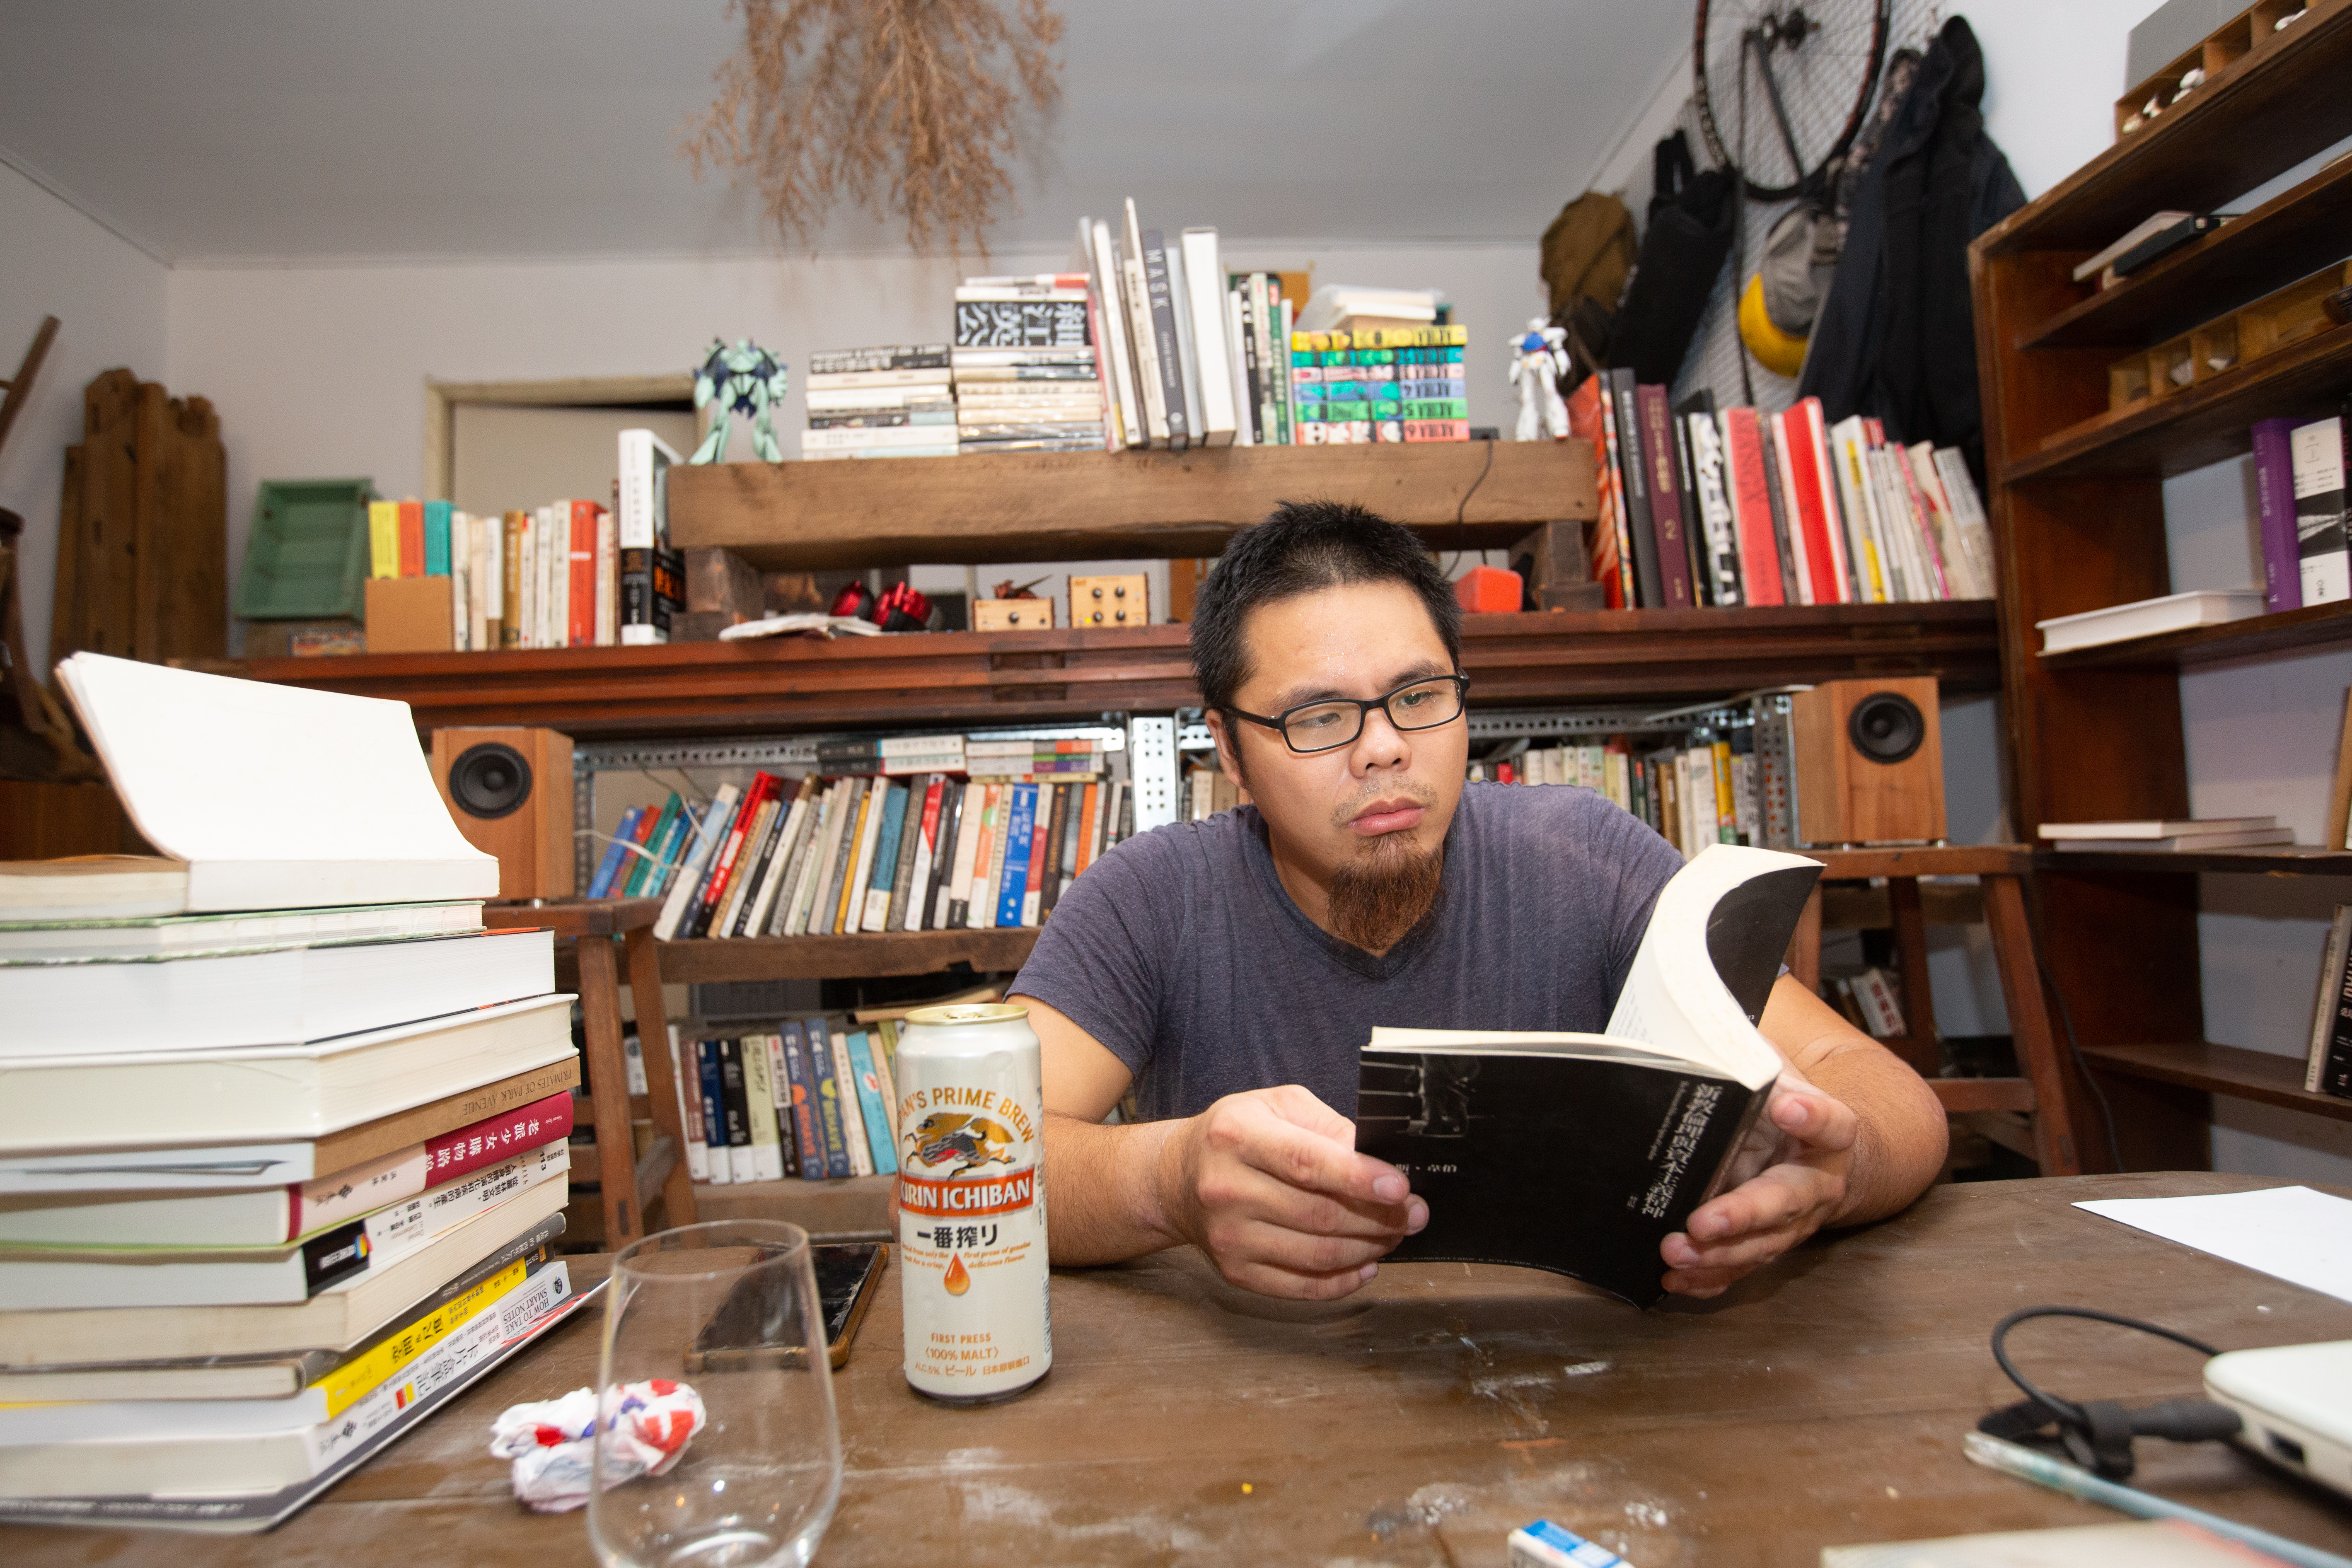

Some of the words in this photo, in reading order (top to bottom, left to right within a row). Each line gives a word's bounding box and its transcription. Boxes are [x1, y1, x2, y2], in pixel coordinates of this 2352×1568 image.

[958, 302, 1086, 346] 細江英公
[525, 1082, 535, 1094] OF
[538, 1069, 572, 1089] PRIMATES
[501, 1085, 522, 1103] PARK
[463, 1094, 496, 1116] AVENUE
[931, 1086, 996, 1111] PRIME
[998, 1098, 1034, 1144] BREW
[1641, 1082, 1724, 1219] 新教倫理與資本主義精神
[900, 1181, 938, 1210] KIRIN
[942, 1177, 1030, 1210] ICHIBAN
[917, 1223, 998, 1249] 一番搾り
[526, 1288, 547, 1309] SMART
[534, 1297, 549, 1316] HOW
[503, 1302, 526, 1324] NOTES
[524, 1311, 534, 1322] TO
[505, 1317, 523, 1335] TAKE
[931, 1332, 955, 1344] FIRST
[960, 1332, 991, 1344] PRESS
